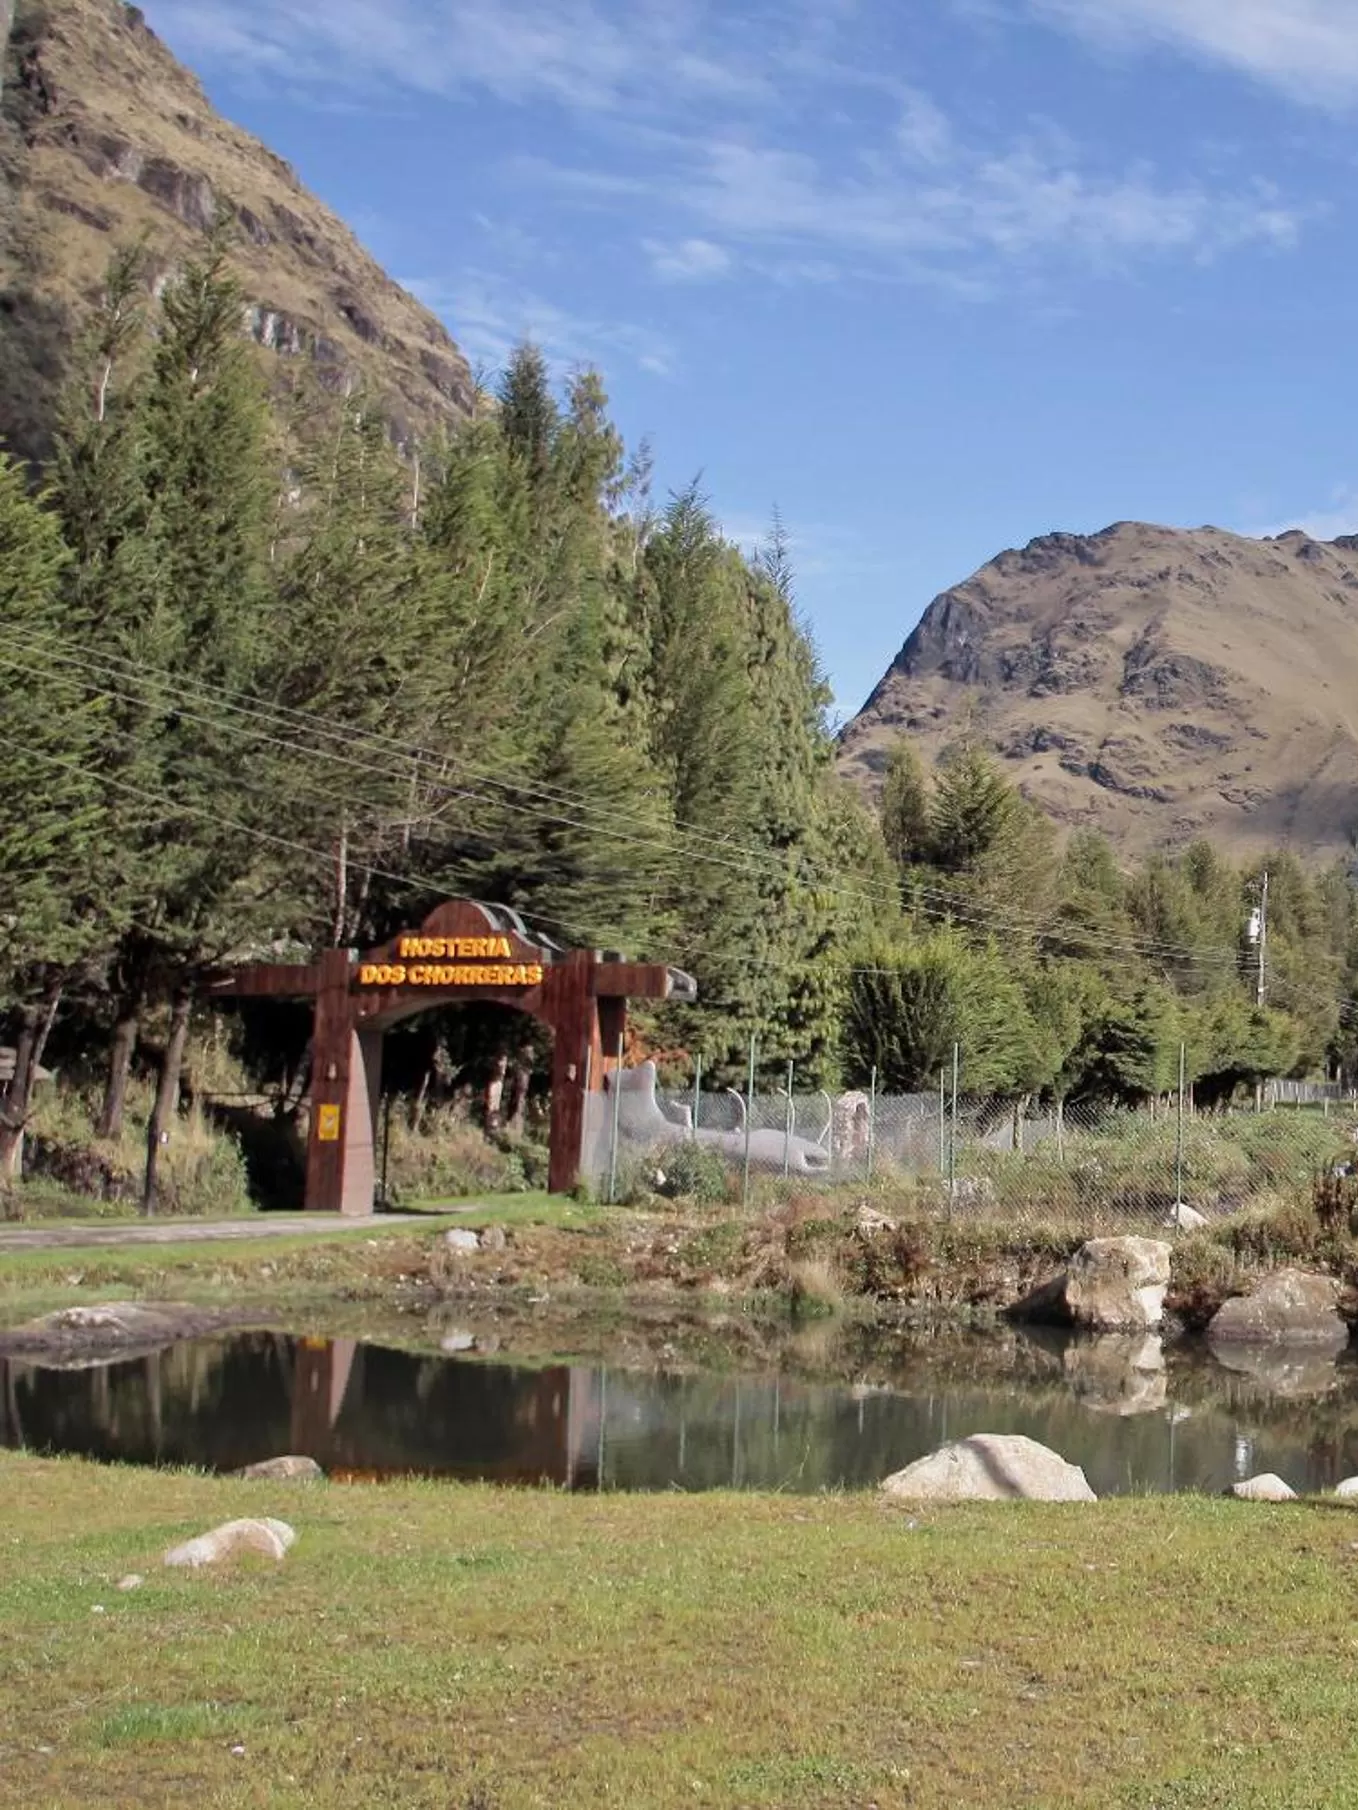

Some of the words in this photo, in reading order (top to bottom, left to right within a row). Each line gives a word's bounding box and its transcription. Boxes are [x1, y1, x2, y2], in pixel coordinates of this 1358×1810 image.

[398, 936, 513, 959] HOSTERIA
[360, 963, 405, 985] DOS
[408, 963, 543, 986] CHORRERAS
